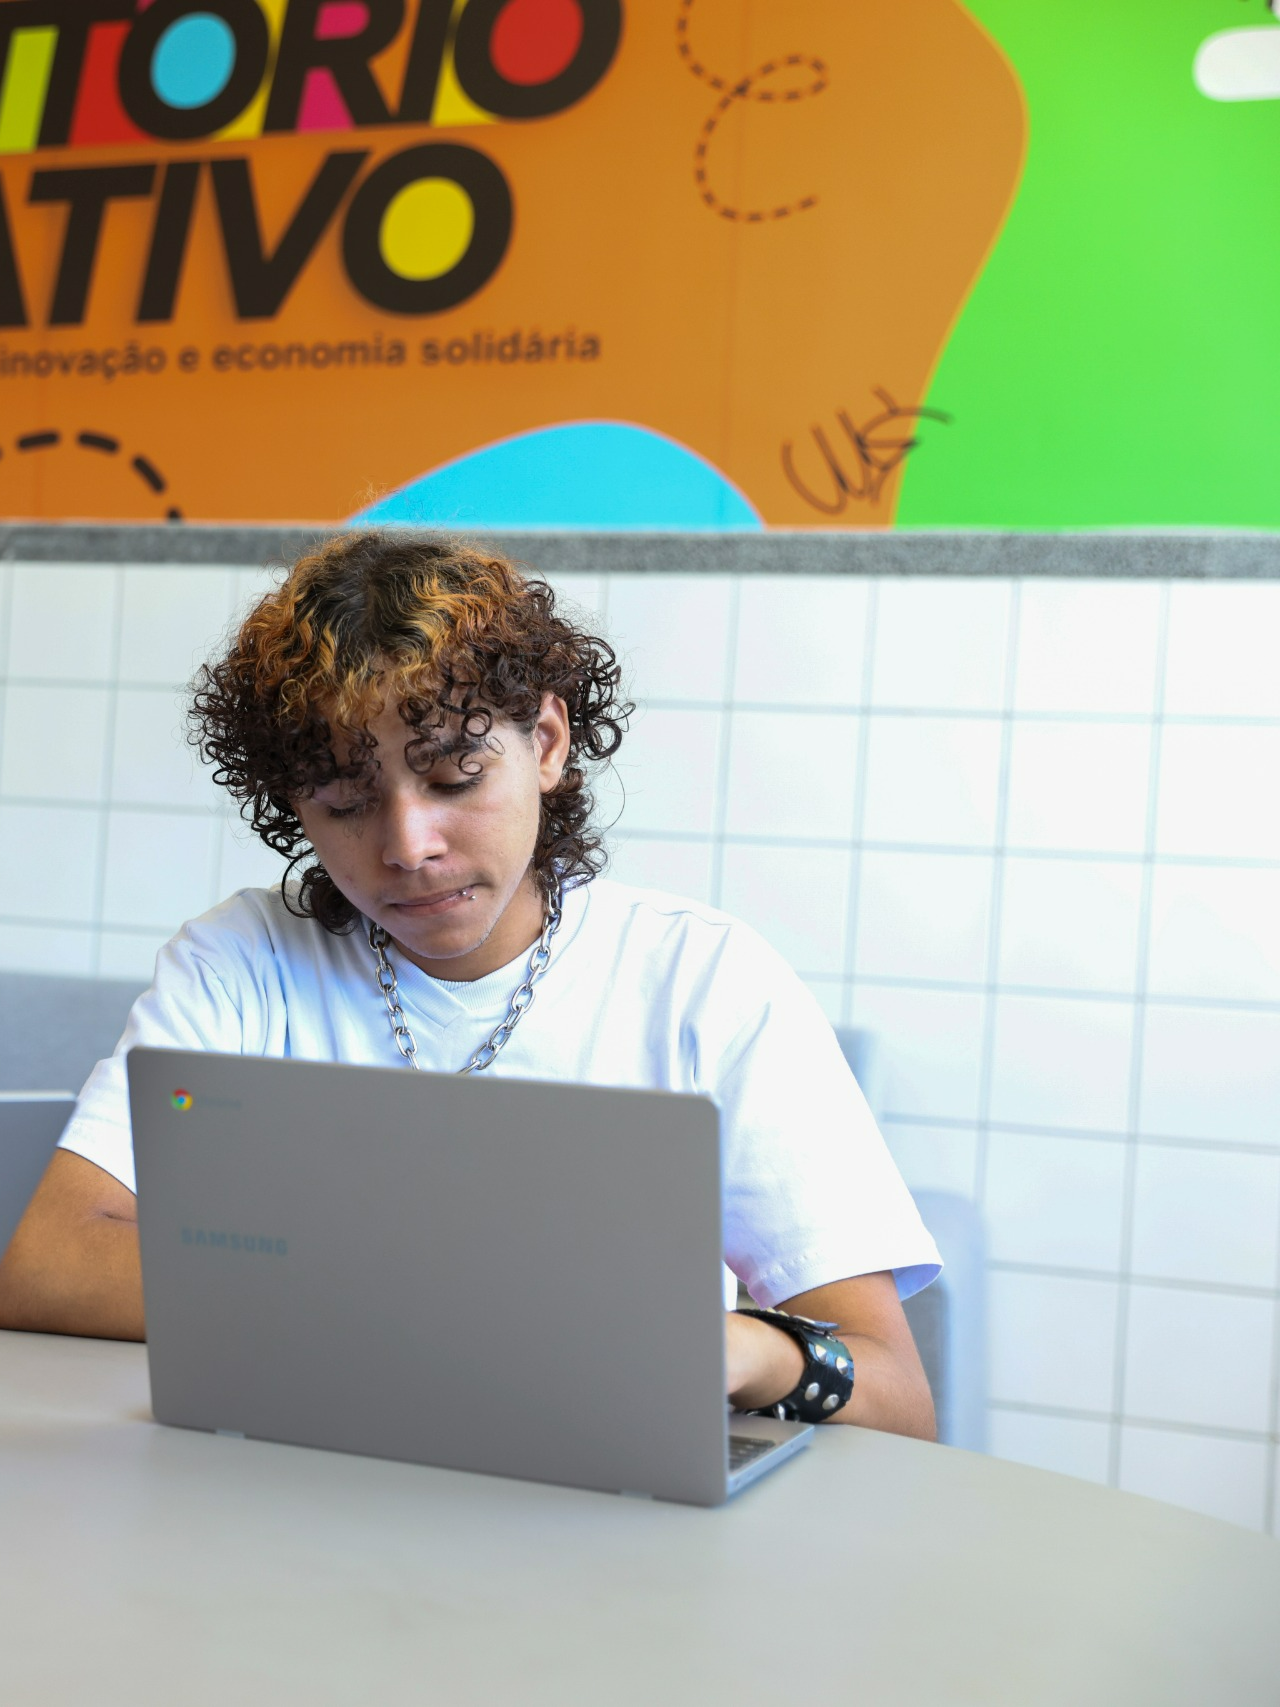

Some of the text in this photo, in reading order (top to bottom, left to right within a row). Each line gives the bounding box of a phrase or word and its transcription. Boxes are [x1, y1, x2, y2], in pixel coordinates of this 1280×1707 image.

[177, 346, 201, 374] e
[211, 332, 407, 371] economia
[422, 327, 602, 367] solidária
[181, 1226, 288, 1257] SAMSUNG
